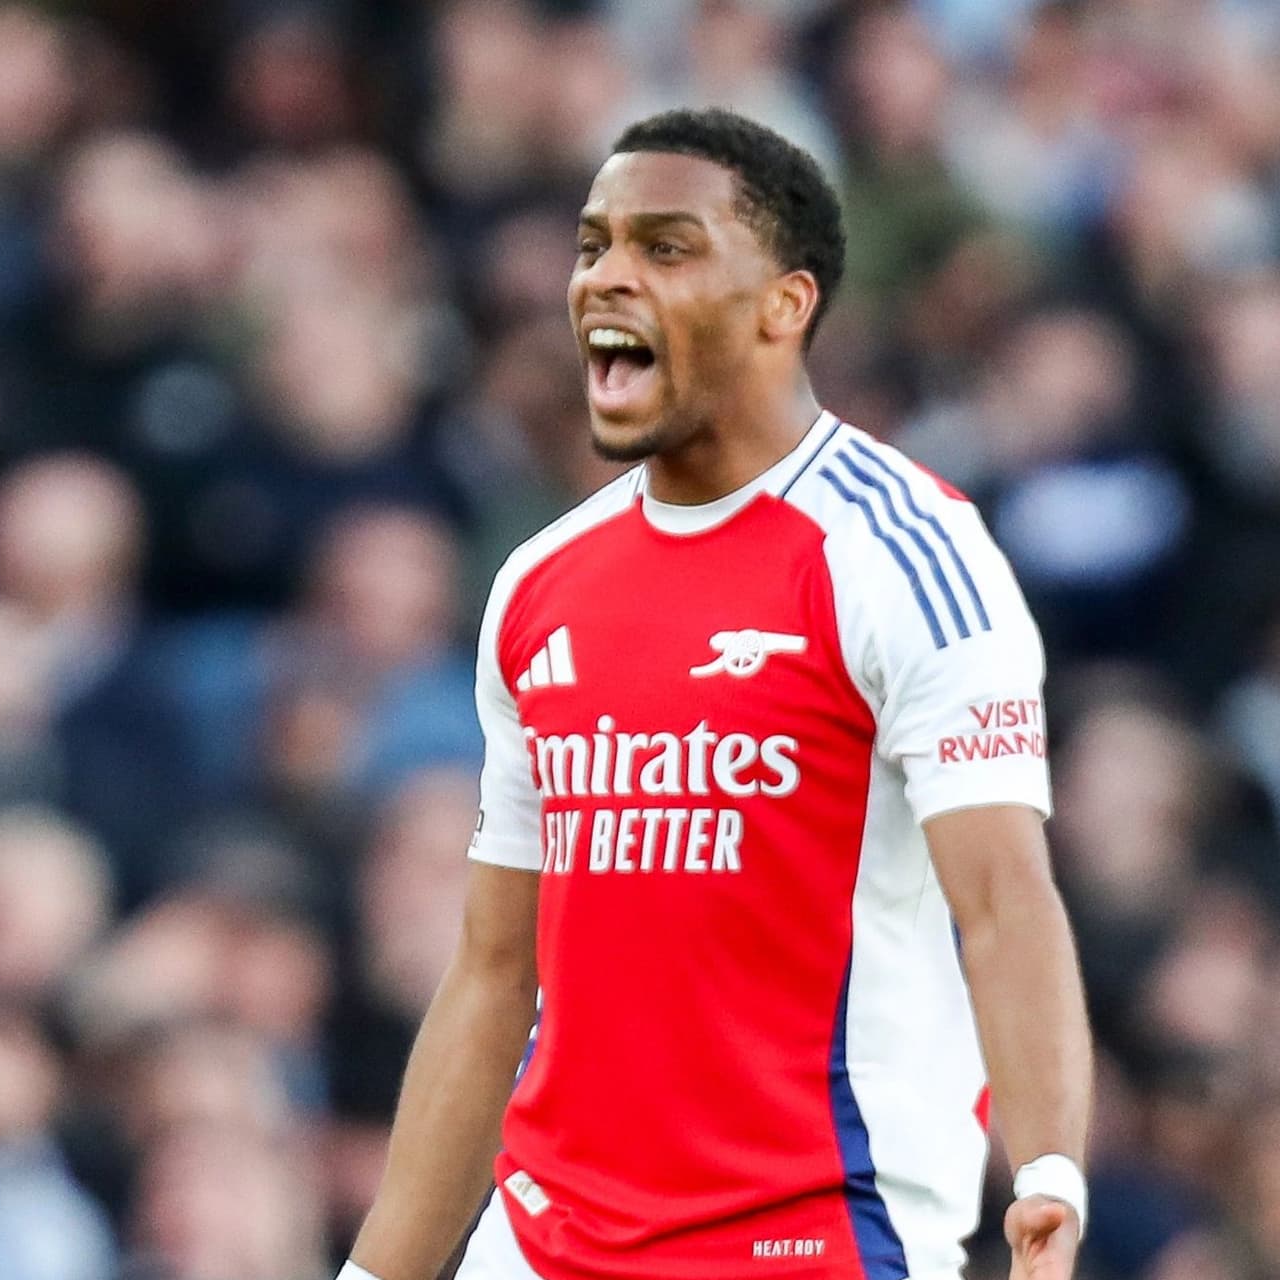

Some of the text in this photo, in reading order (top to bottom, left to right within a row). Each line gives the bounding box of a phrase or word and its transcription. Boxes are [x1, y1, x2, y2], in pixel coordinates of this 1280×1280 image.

[968, 699, 1038, 729] VISIT
[938, 732, 1047, 763] RWAND
[589, 808, 742, 873] BETTER
